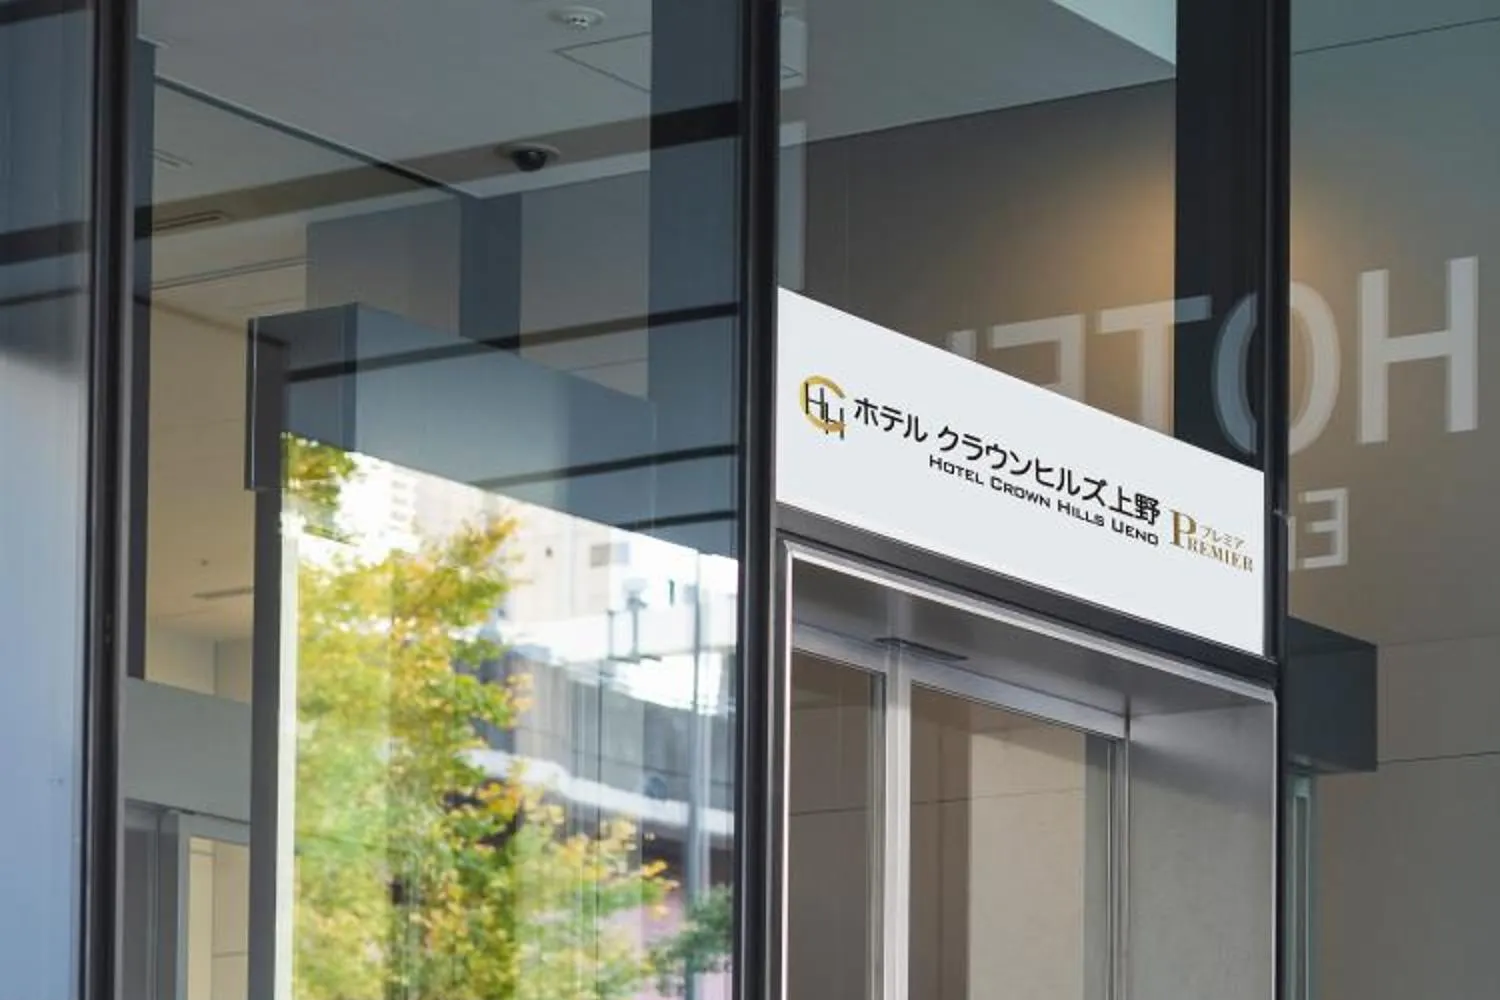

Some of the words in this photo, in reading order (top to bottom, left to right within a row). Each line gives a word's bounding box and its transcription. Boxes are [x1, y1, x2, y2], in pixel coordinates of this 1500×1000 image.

[853, 397, 929, 442] ホテル
[938, 425, 1160, 526] クラウンヒルズ上野
[929, 454, 984, 485] HOTEL
[990, 476, 1051, 508] CROWN
[1057, 499, 1105, 527] HILLS
[1111, 518, 1159, 546] UENO
[1169, 508, 1254, 573] PREMIER
[1199, 524, 1246, 550] プレミア
